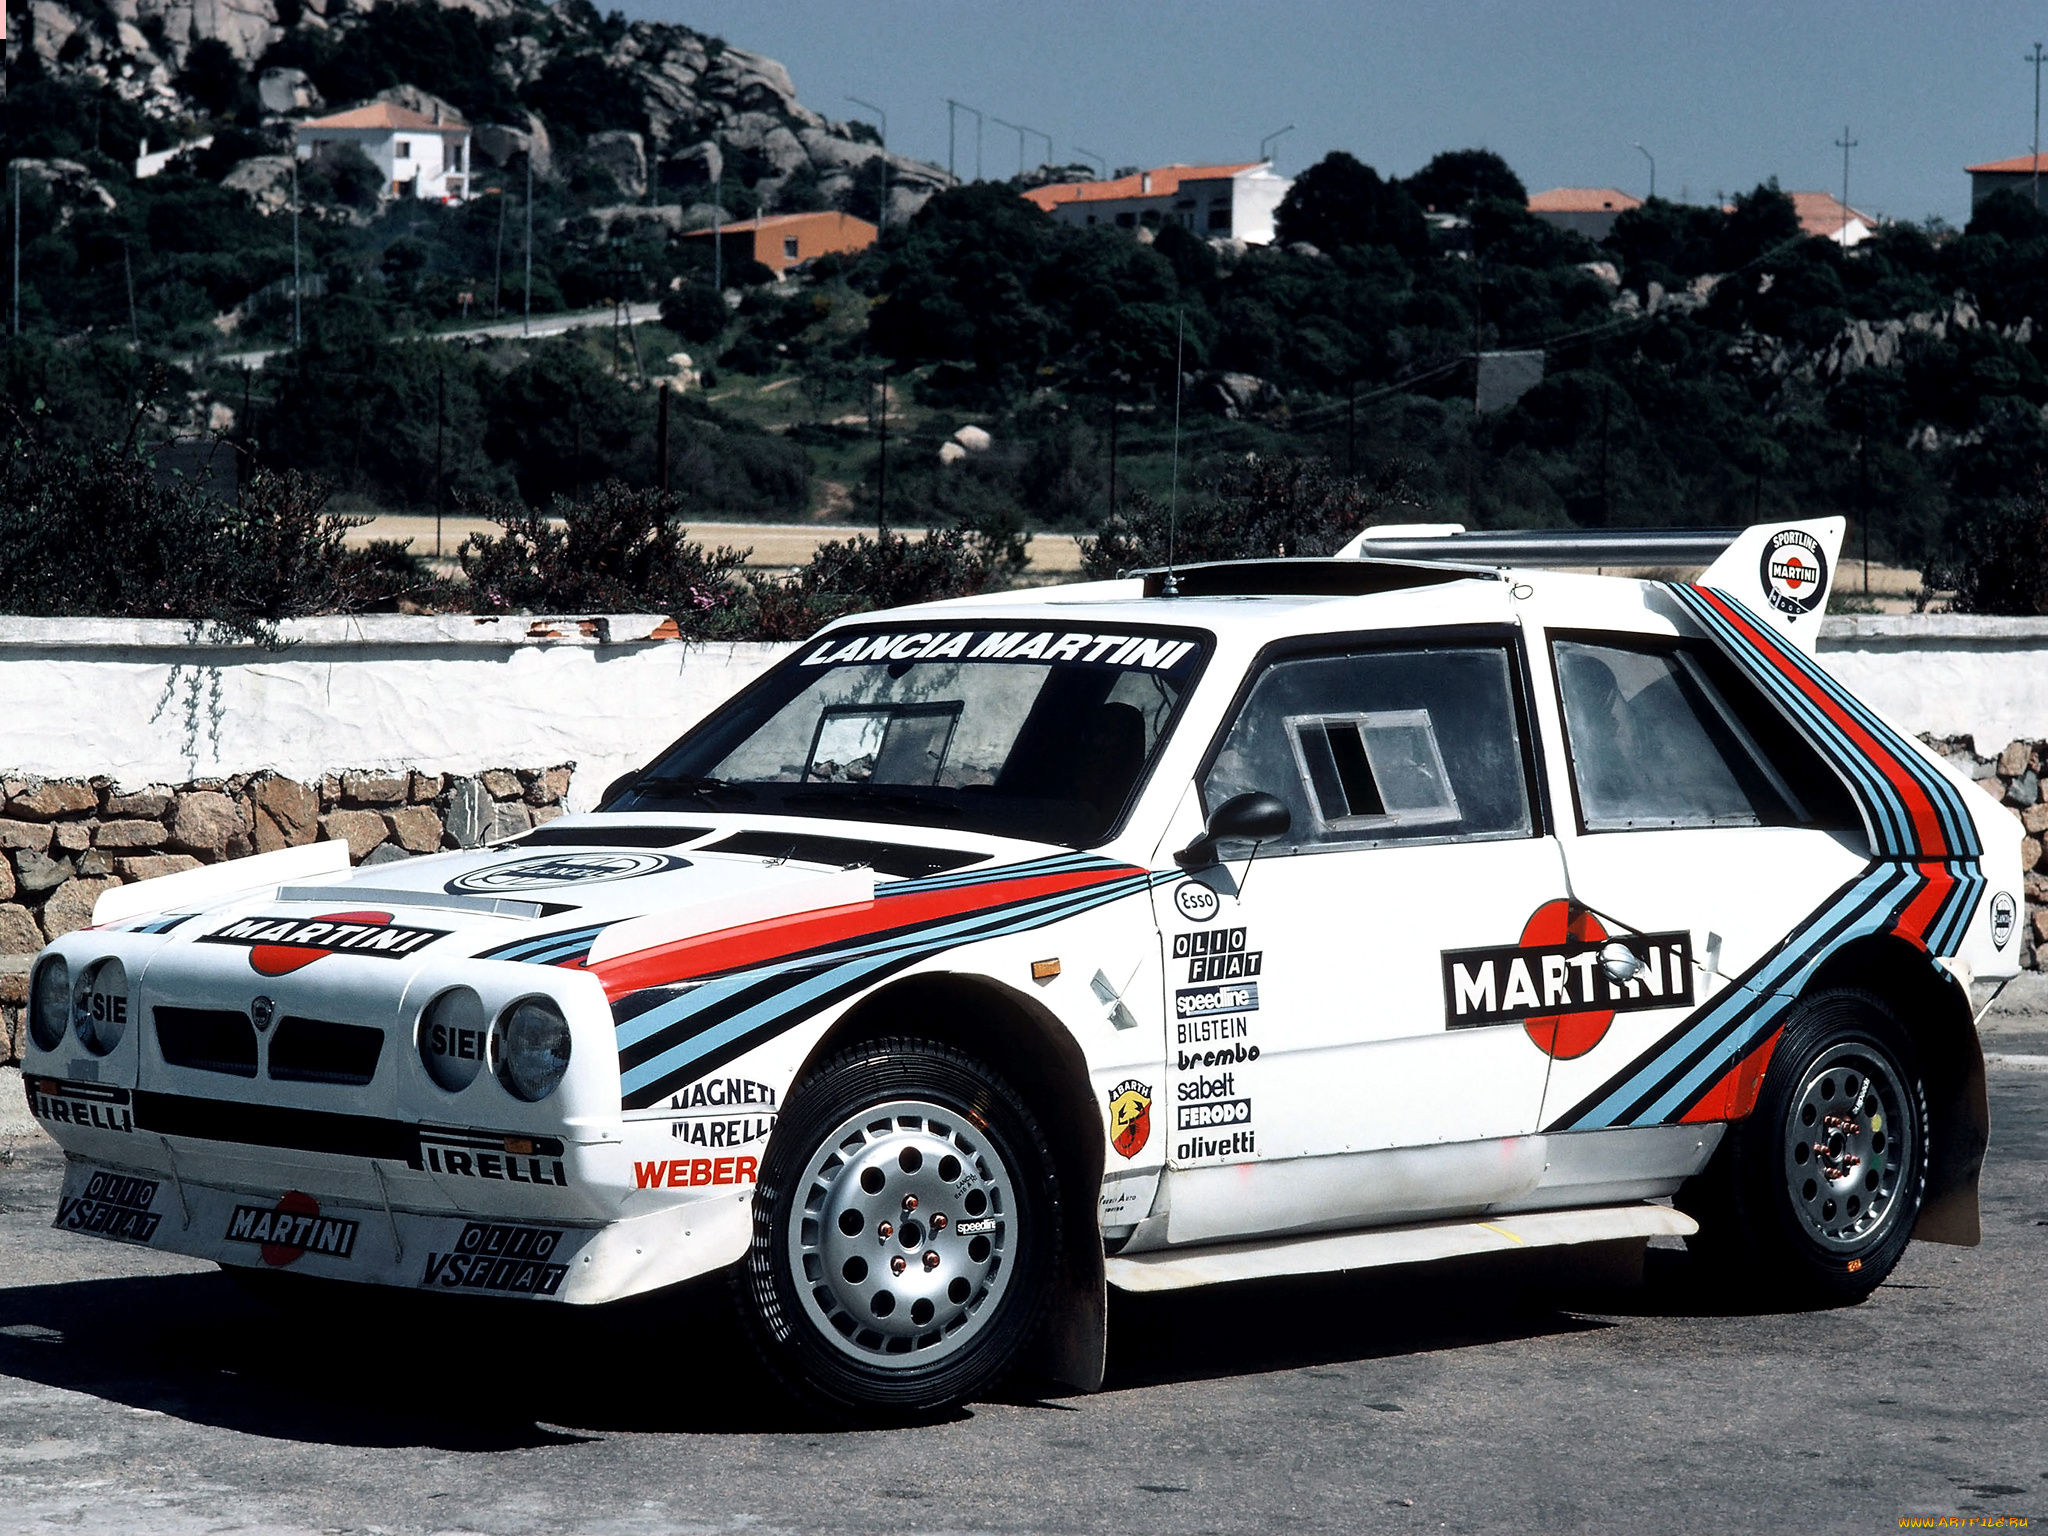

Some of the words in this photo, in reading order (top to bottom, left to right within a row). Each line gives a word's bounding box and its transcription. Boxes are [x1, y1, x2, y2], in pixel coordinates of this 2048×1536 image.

[1773, 531, 1818, 553] SPORTLINE
[1773, 564, 1816, 582] MARTINI
[800, 632, 971, 667] LANCIA
[971, 632, 1196, 670] MARTINI
[220, 919, 434, 953] MARTINI
[1175, 929, 1245, 957] OLIO
[1191, 953, 1261, 981] FIAT
[1176, 984, 1250, 1015] speedline
[1177, 1016, 1248, 1044] BILSTEIN
[1177, 1042, 1261, 1071] brembo
[671, 1078, 776, 1110] MAGNETI
[1112, 1080, 1149, 1101] ABARTH
[1177, 1072, 1236, 1101] sabelt
[1179, 1101, 1249, 1128] FERODO
[671, 1115, 777, 1148] MARELLI
[1177, 1131, 1255, 1160] olivetti
[633, 1155, 758, 1189] WEBER
[88, 1175, 154, 1206] OLIO
[91, 1205, 158, 1238] FIAT
[230, 1208, 353, 1254] MARTINI
[463, 1228, 554, 1257] OLIO
[469, 1261, 563, 1290] FIAT
